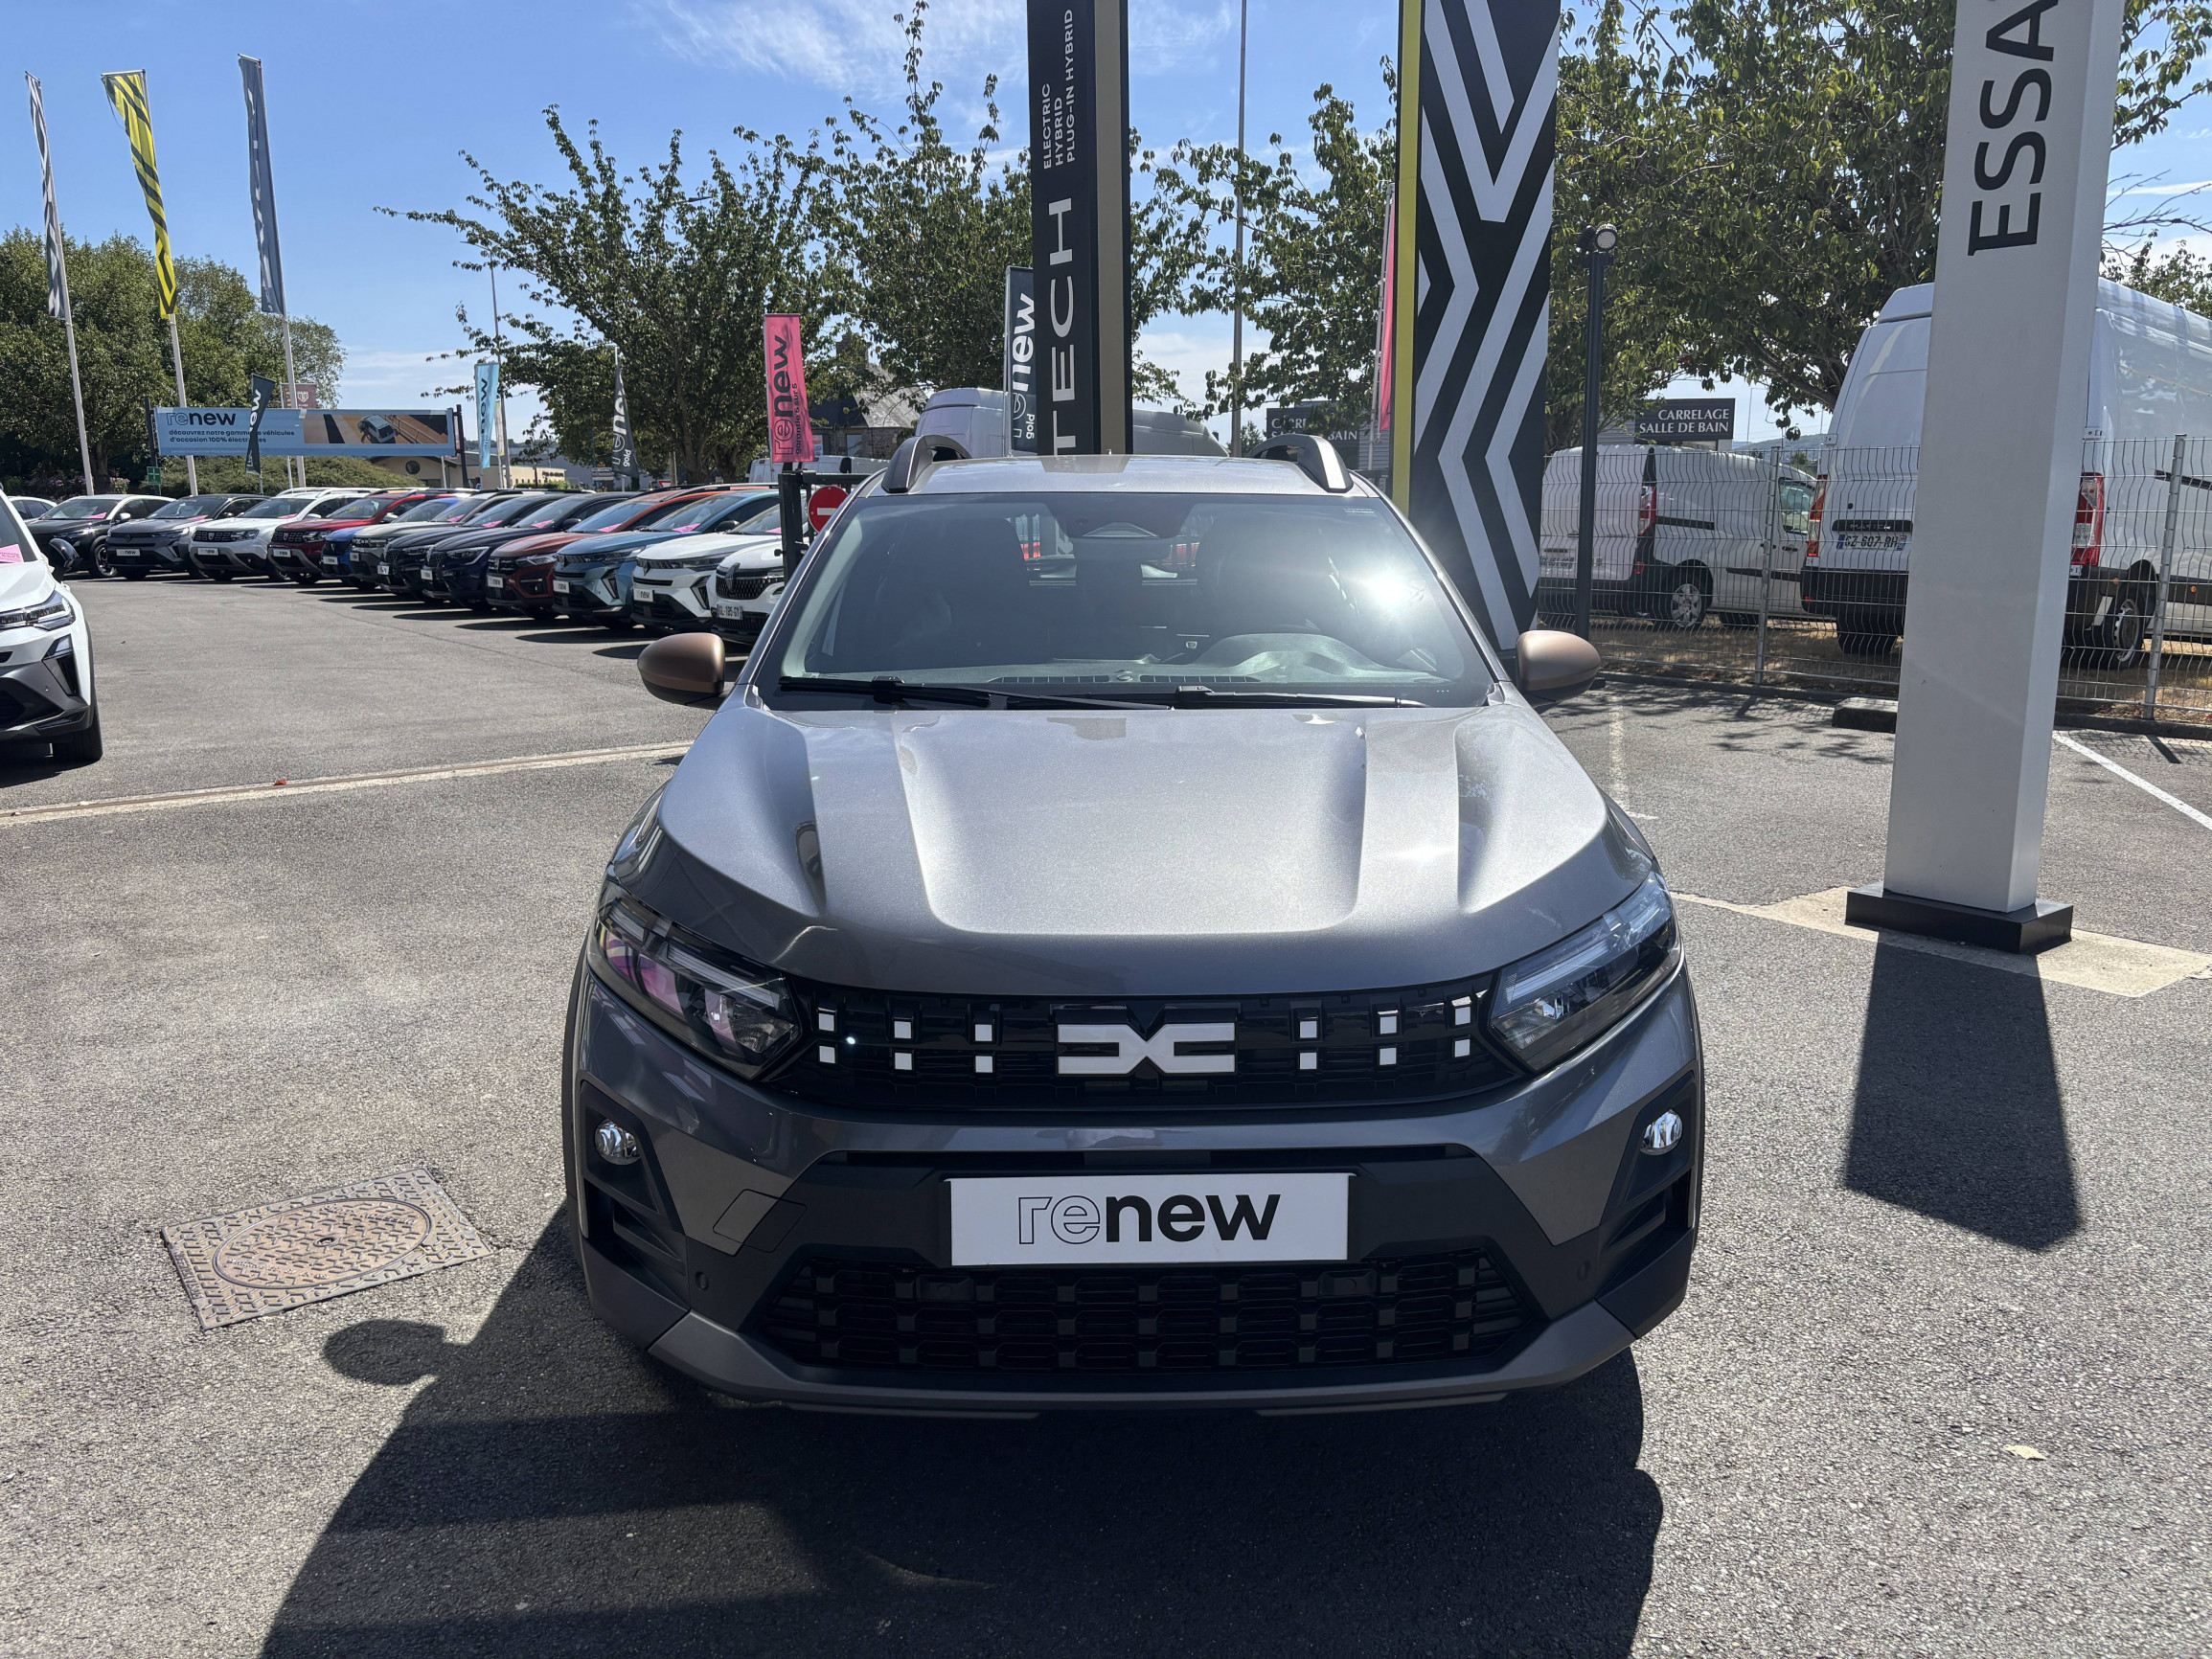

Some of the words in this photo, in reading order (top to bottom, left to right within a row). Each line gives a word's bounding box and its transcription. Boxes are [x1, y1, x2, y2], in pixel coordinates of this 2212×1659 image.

[1064, 9, 1074, 81] HYBRID
[1041, 82, 1052, 170] ELECTRIC
[1054, 97, 1063, 167] HYBRID
[1065, 85, 1075, 163] PLUG-IN
[166, 412, 237, 426] renew
[773, 334, 794, 456] renew
[1658, 408, 1729, 420] CARRELAGE
[1025, 413, 1036, 440] gold
[1639, 422, 1675, 434] SALLE
[1677, 422, 1695, 433] DE
[1698, 421, 1729, 433] BAIN
[1018, 1193, 1281, 1245] renew
